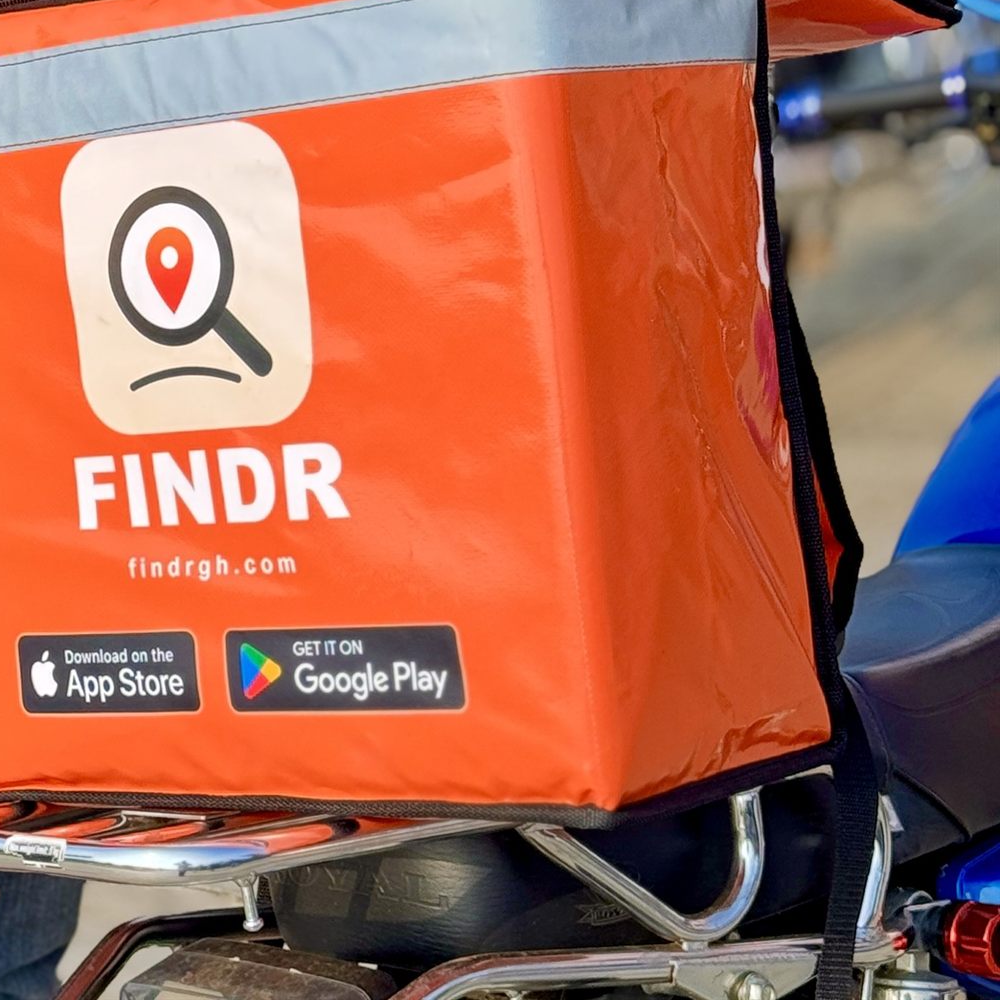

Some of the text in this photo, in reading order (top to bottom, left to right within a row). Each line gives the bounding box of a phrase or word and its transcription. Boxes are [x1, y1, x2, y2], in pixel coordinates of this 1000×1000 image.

[73, 441, 351, 530] FINDR
[127, 554, 297, 581] findrgh.com
[64, 647, 174, 665] Download on the
[292, 639, 364, 656] GET IT ON
[66, 667, 185, 703] App Store
[293, 660, 448, 701] Google Play
